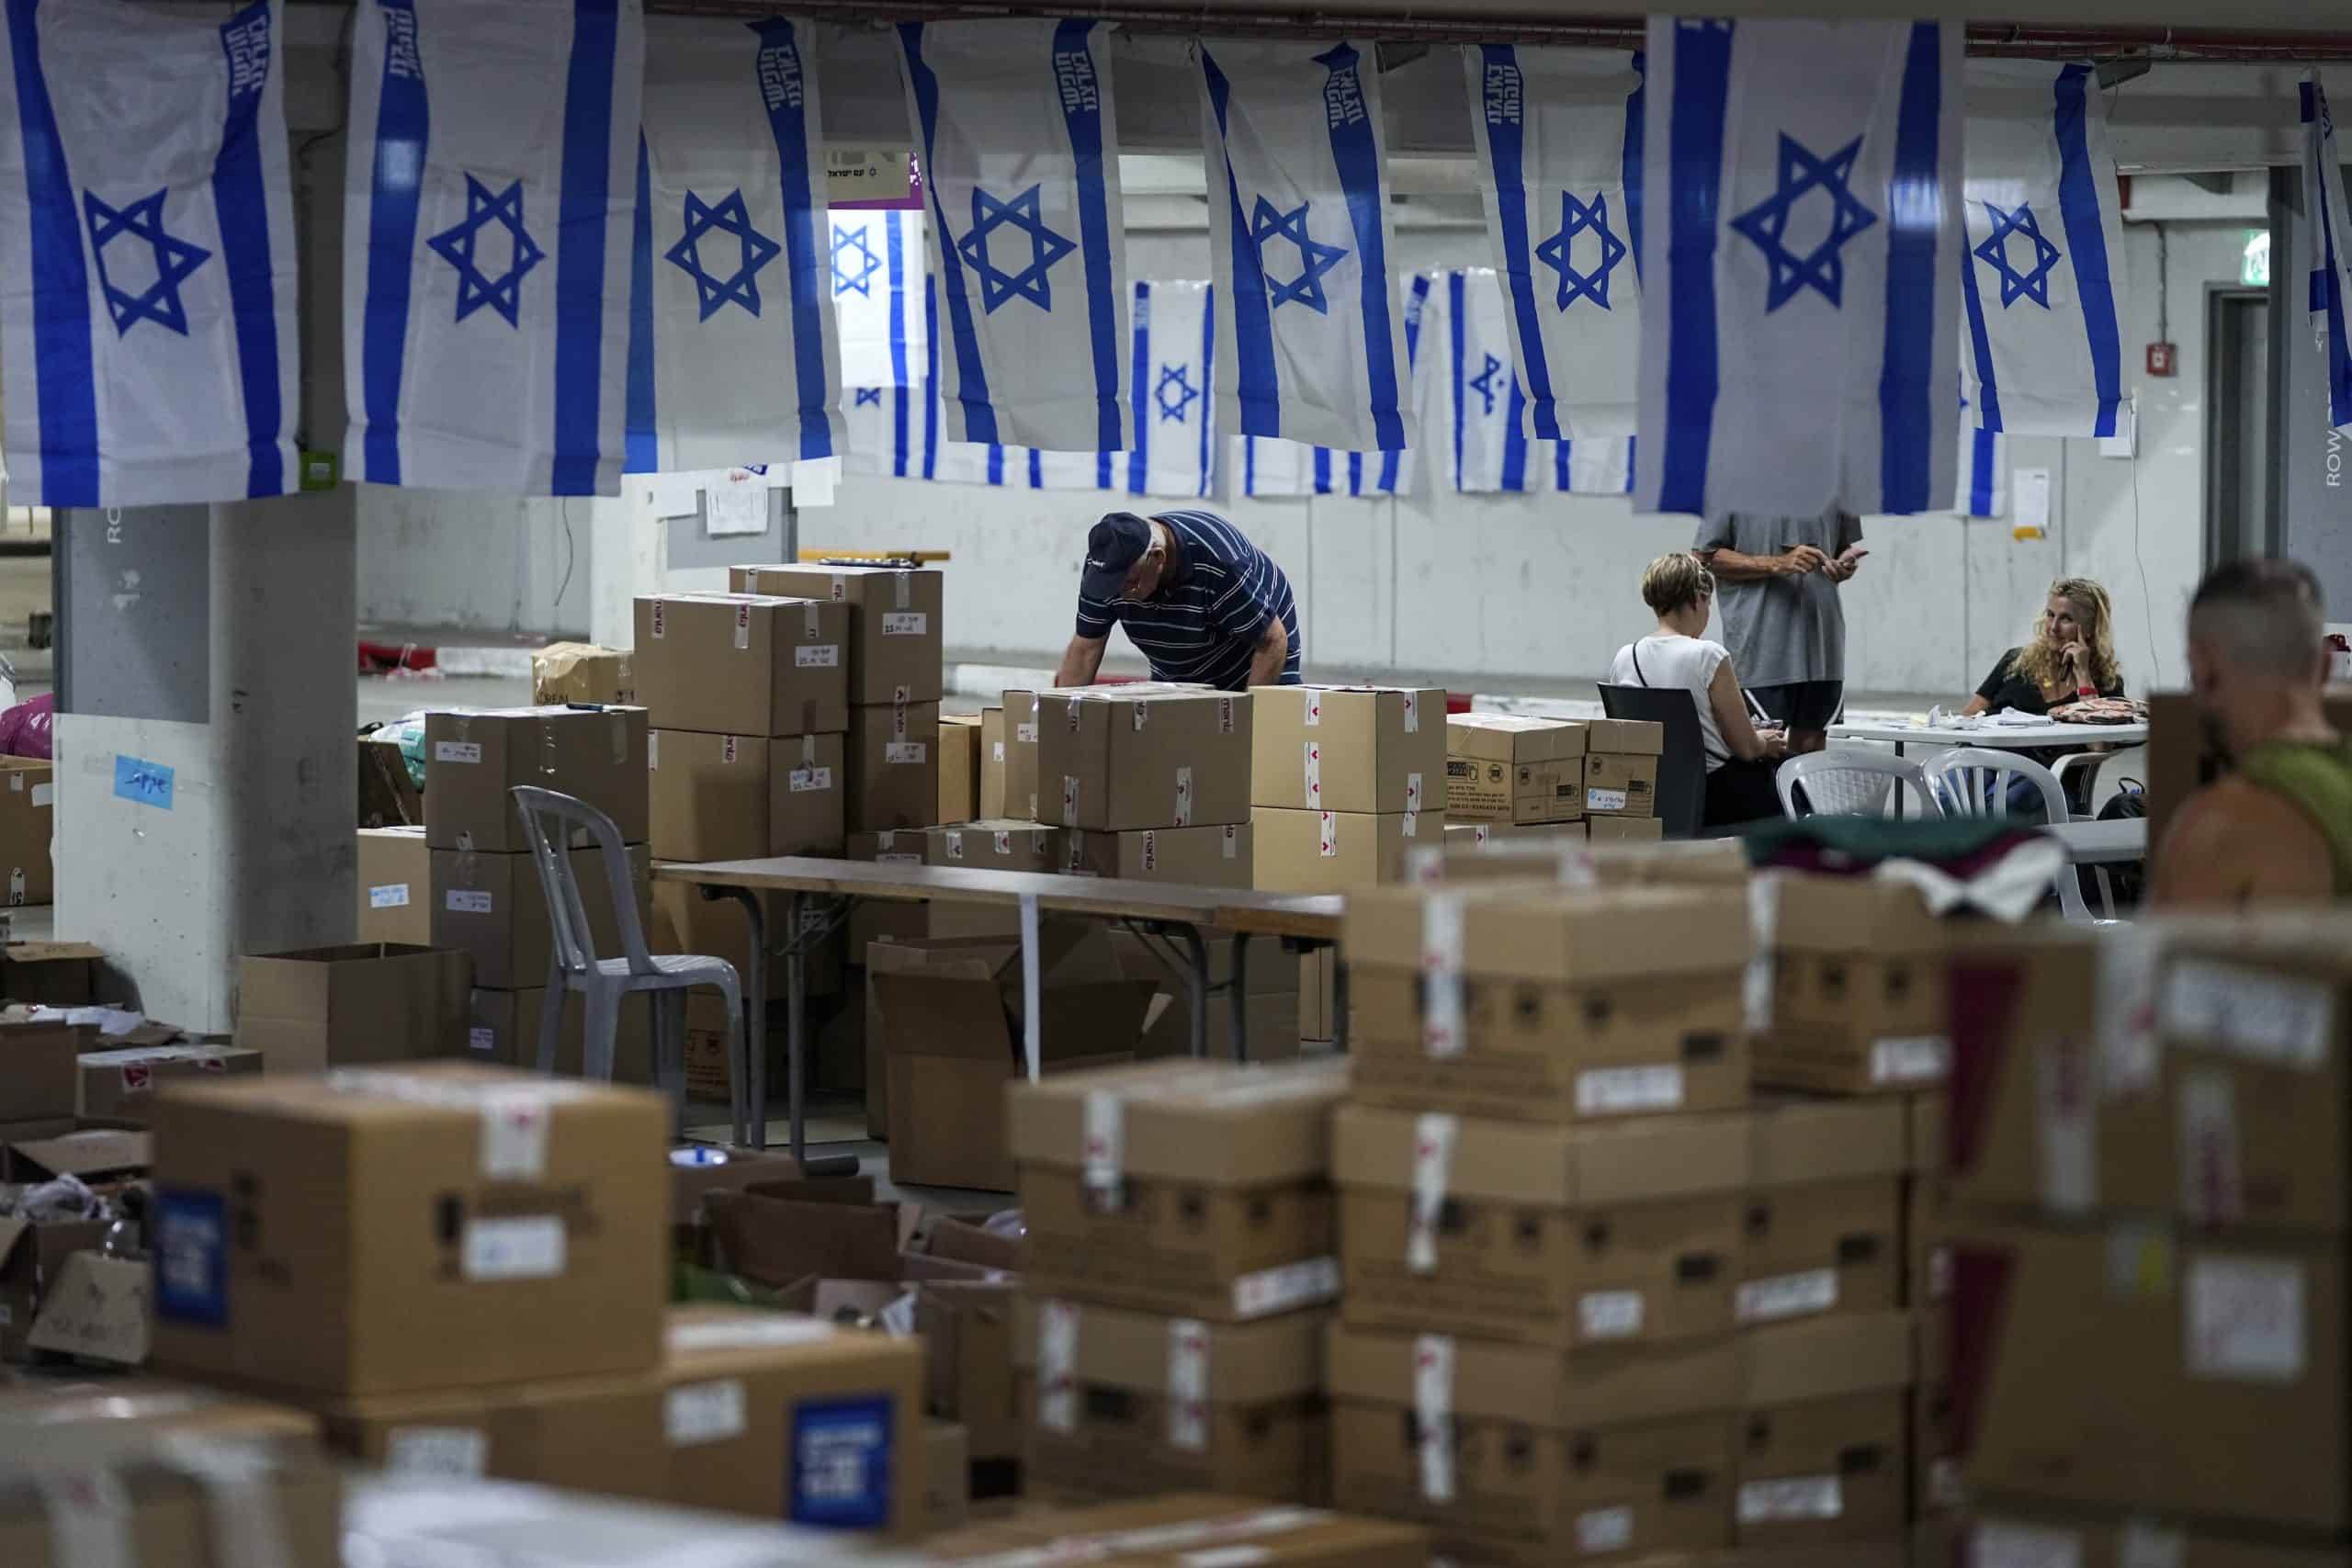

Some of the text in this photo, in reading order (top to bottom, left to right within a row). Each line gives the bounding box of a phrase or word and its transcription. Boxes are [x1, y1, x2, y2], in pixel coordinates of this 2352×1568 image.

[760, 48, 787, 111] חופשי
[777, 45, 802, 108] בארצנו
[1056, 51, 1080, 114] חופשי
[1072, 51, 1098, 111] בארצנו
[853, 168, 865, 177] עם
[2326, 429, 2342, 488] ROW
[107, 507, 122, 544] RO
